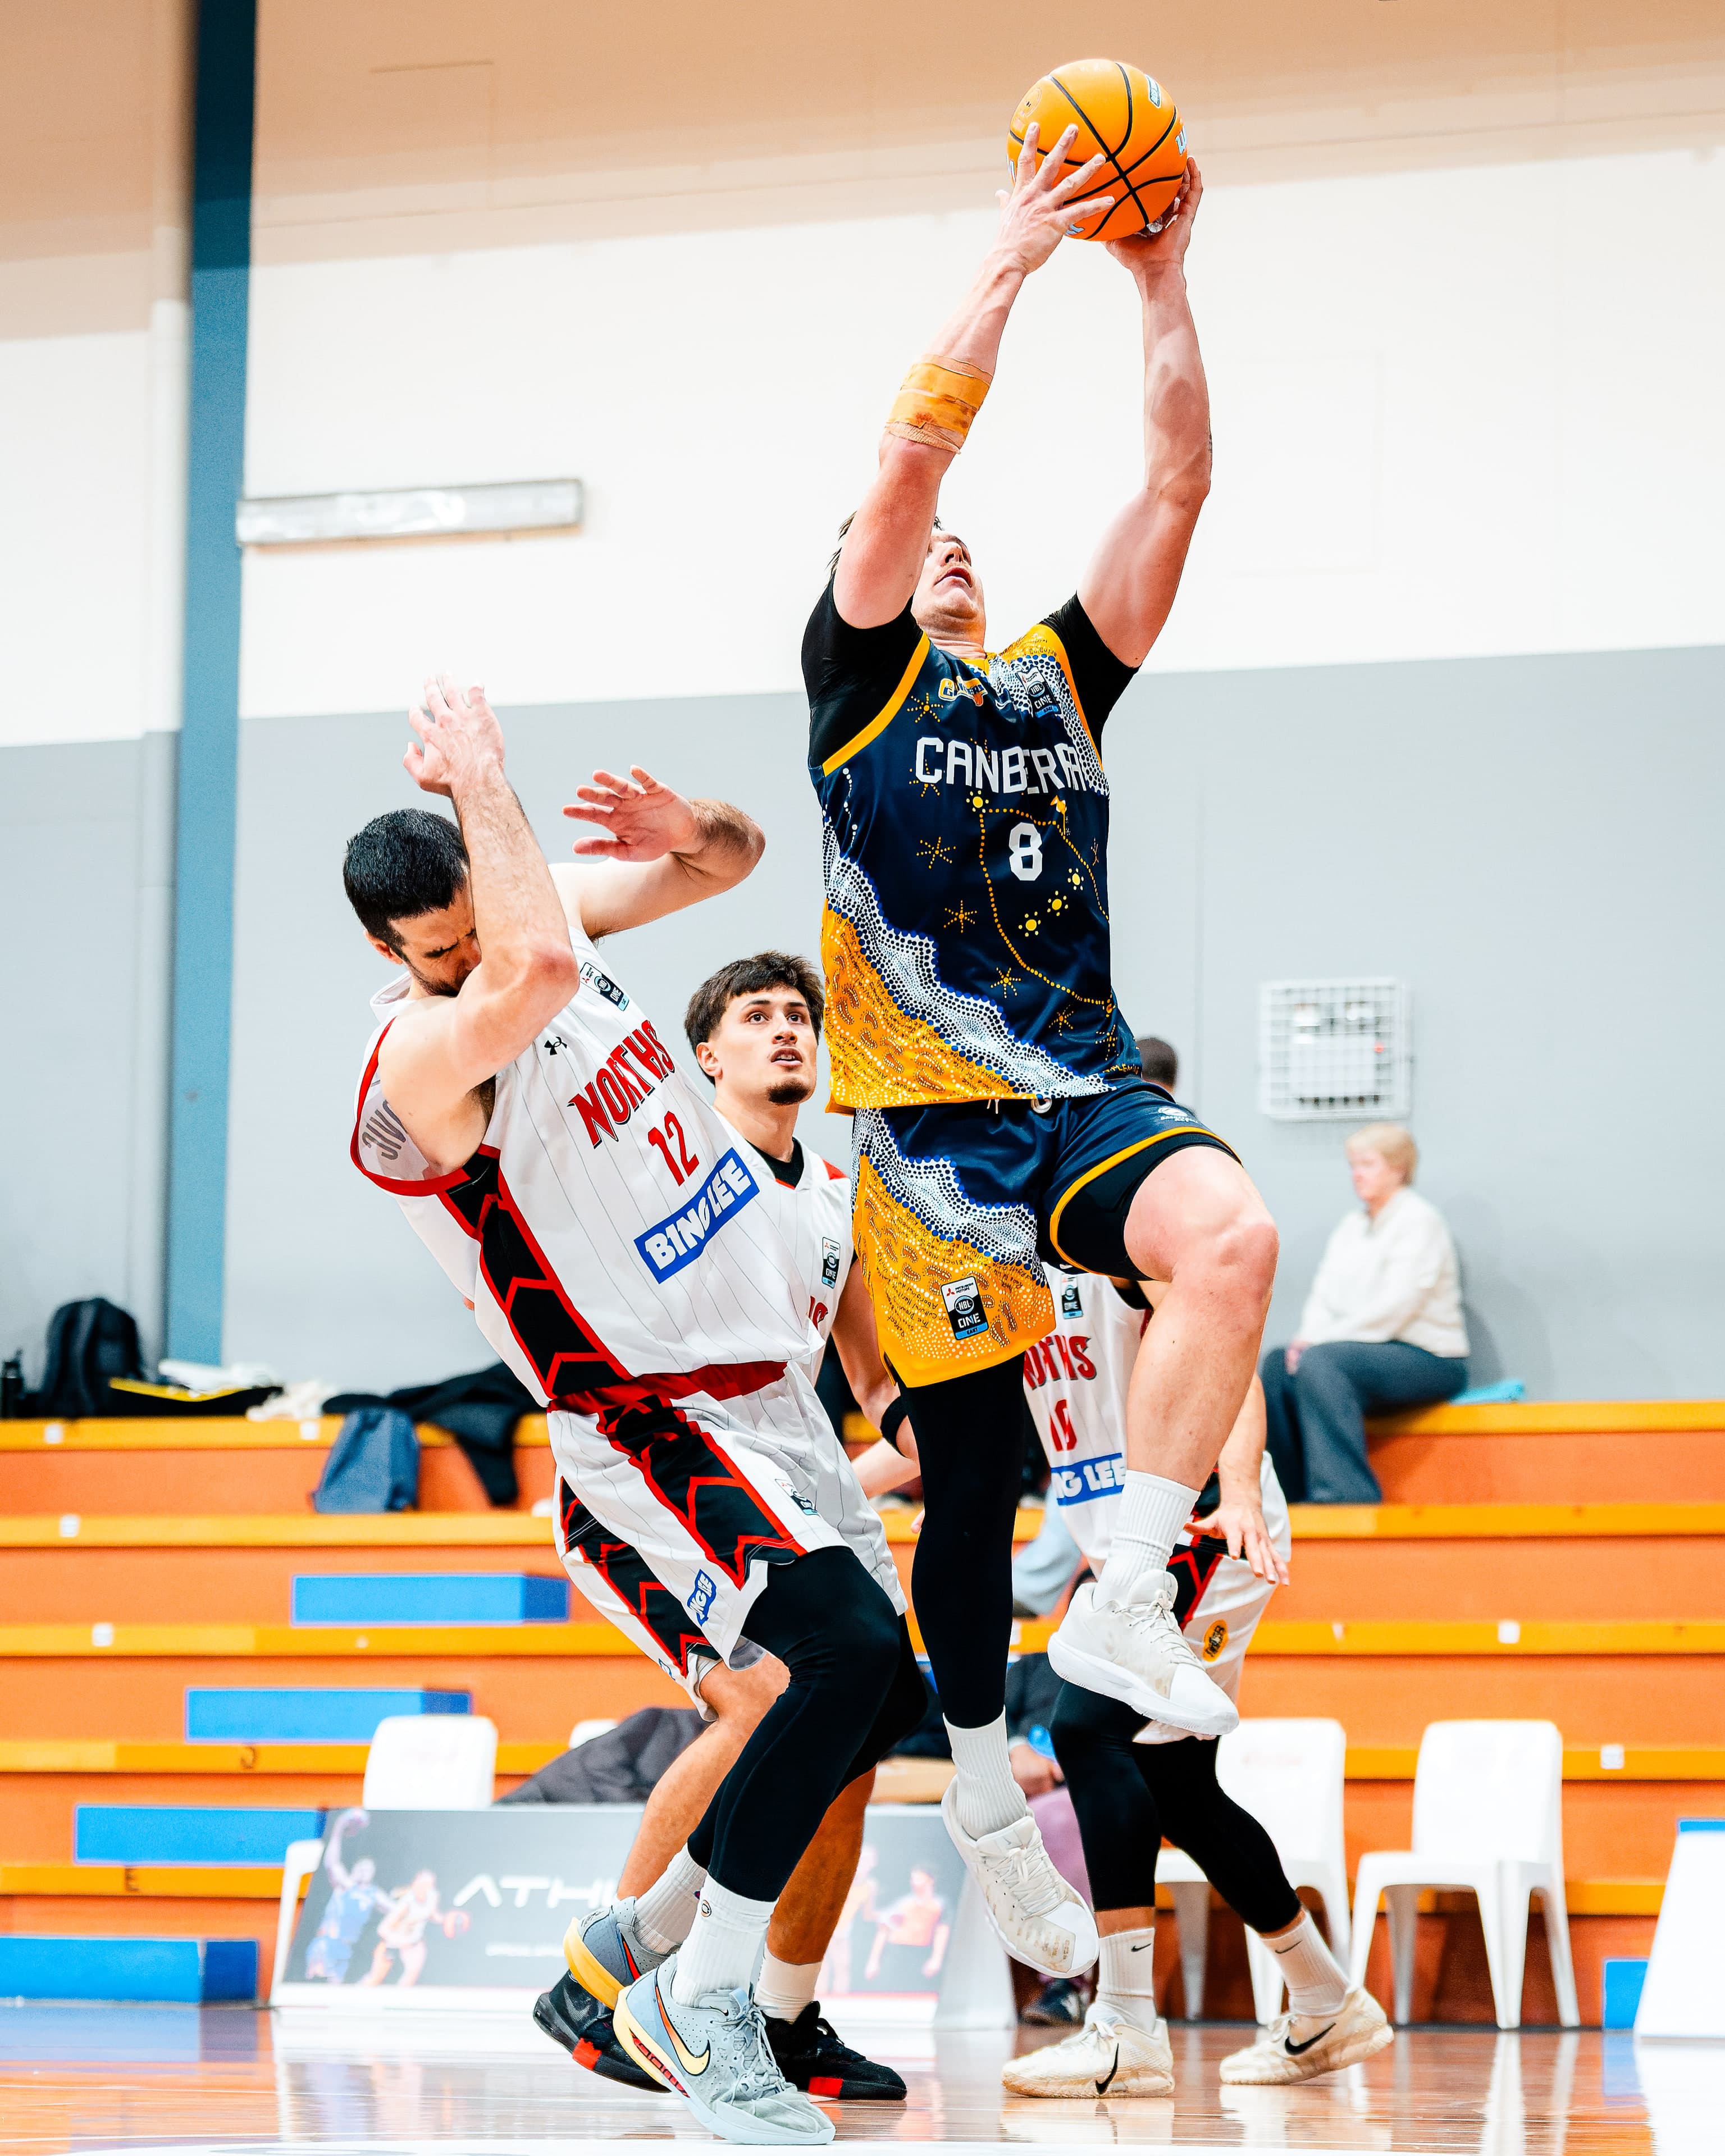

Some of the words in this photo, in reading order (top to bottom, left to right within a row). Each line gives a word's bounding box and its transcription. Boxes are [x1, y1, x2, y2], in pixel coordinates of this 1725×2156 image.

[1008, 823, 1043, 881] 8
[609, 986, 622, 1002] ONE
[567, 1020, 675, 1149] NORTHS
[647, 1110, 700, 1187] 12
[957, 1313, 981, 1329] ONE
[958, 1300, 971, 1310] NBL
